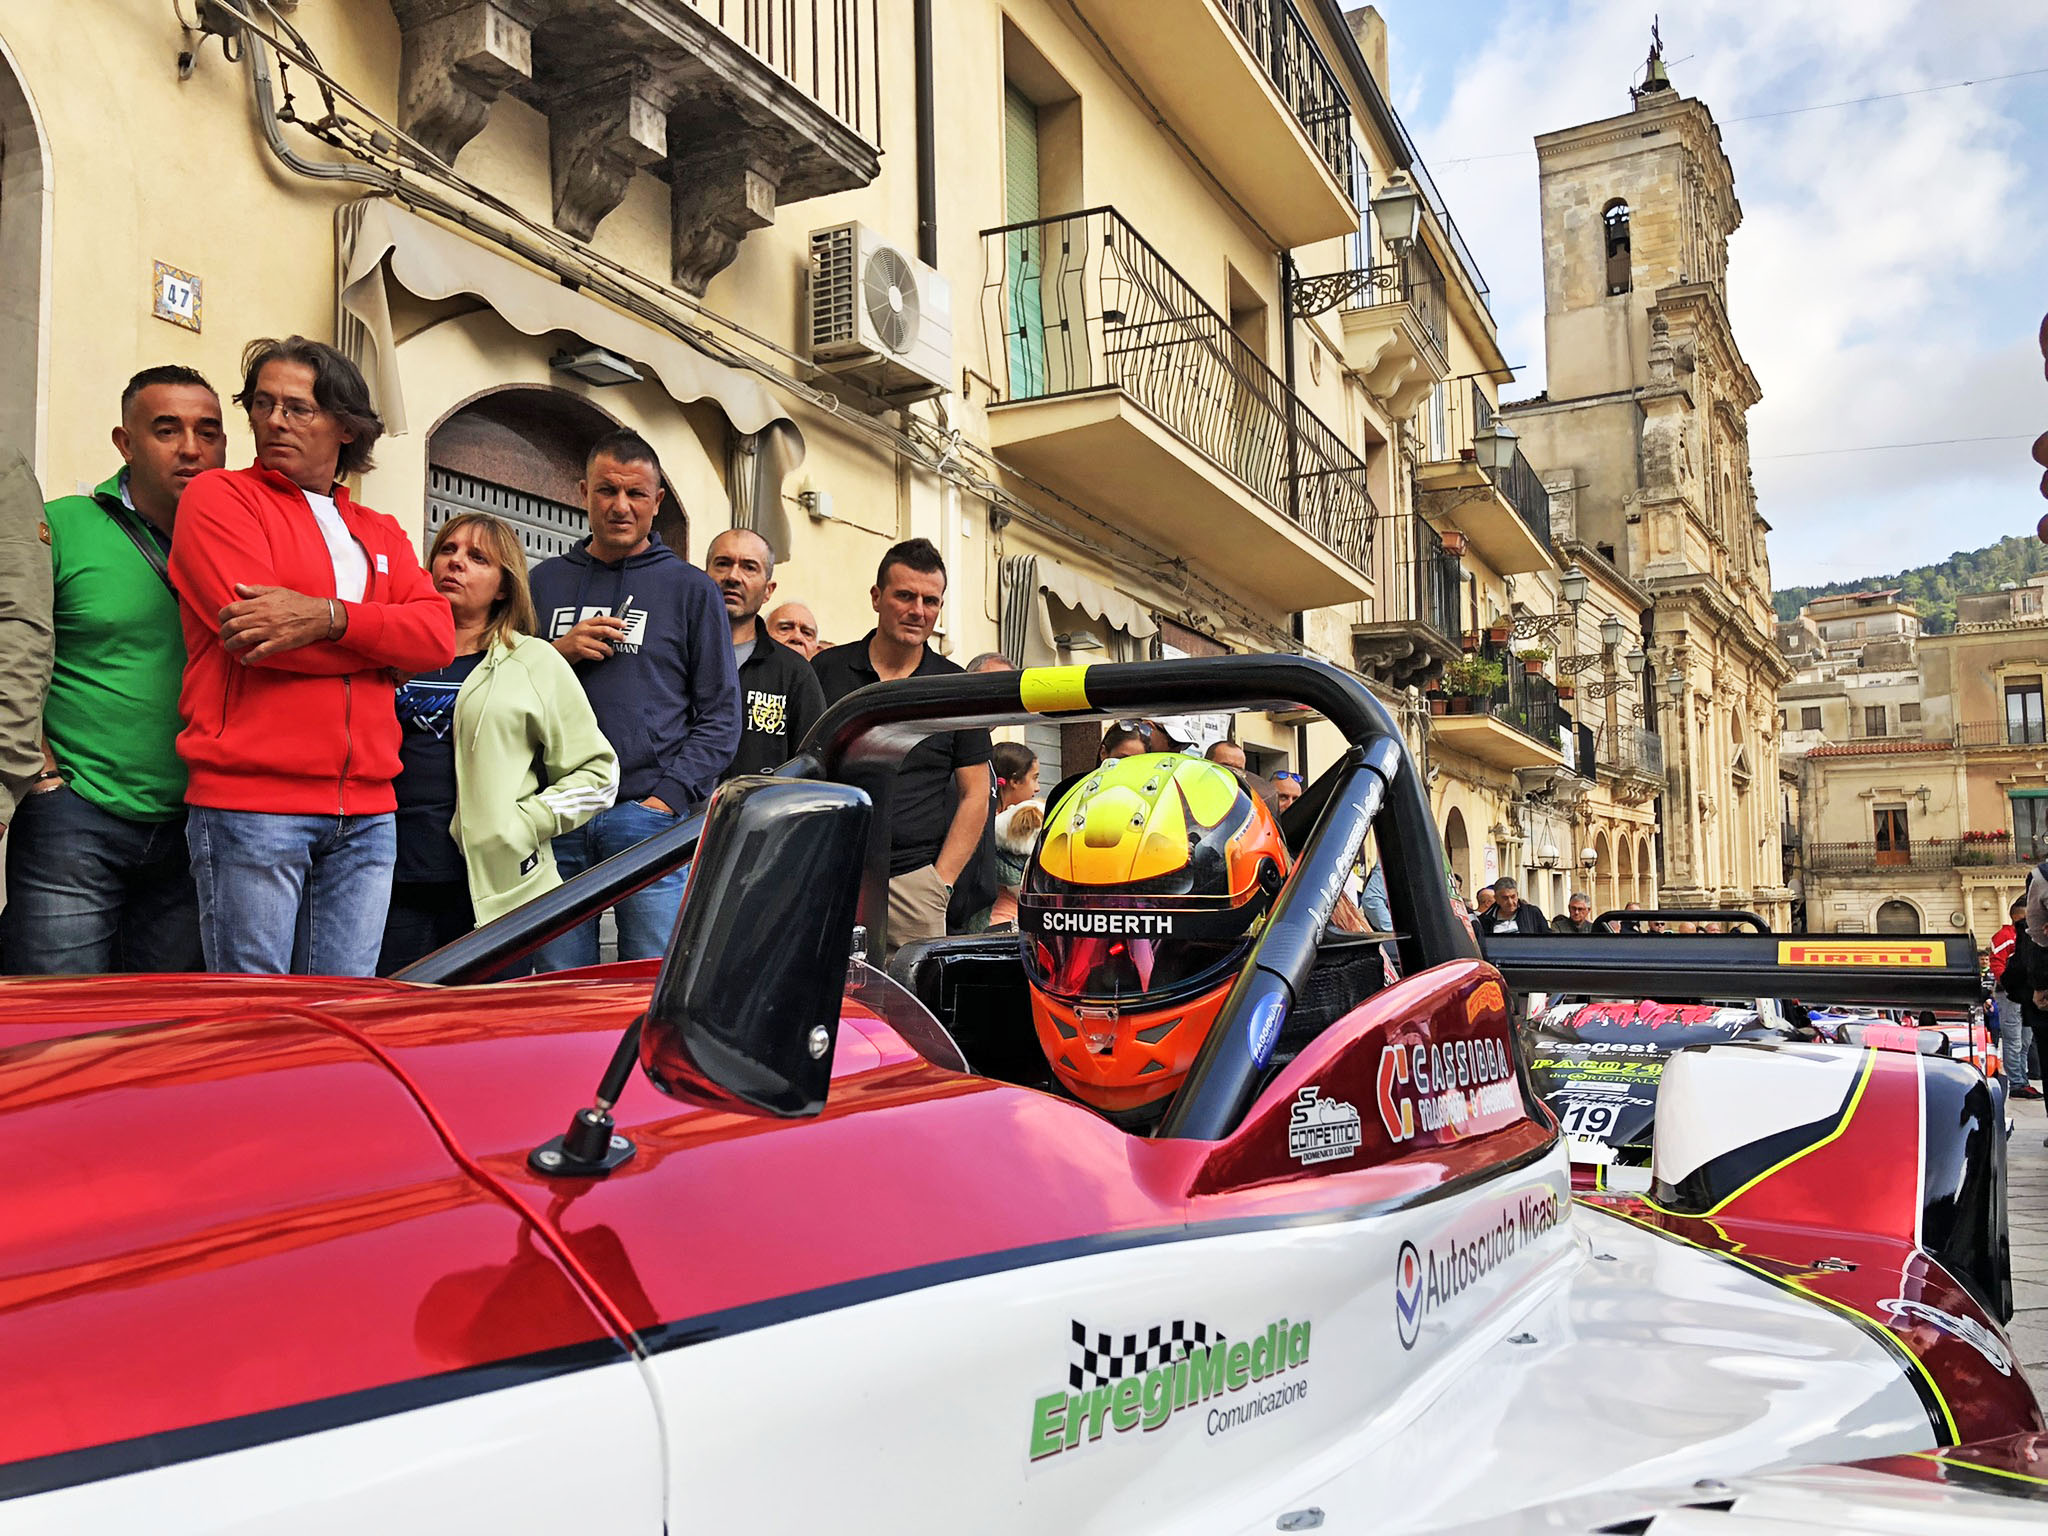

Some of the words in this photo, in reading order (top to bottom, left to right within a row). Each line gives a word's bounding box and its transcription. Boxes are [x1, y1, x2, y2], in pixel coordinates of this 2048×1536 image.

[168, 284, 190, 308] 47
[746, 714, 786, 736] 1982
[1042, 911, 1173, 934] SCHUBERTH
[1789, 946, 1932, 963] PIRELLI
[1534, 1041, 1659, 1053] Ecogest
[1569, 1106, 1612, 1133] 19
[1290, 1122, 1360, 1150] COMPETITION
[1426, 1208, 1515, 1315] Autoscuola
[1519, 1193, 1558, 1249] Nicaso
[1029, 1318, 1311, 1463] ErregiMedia
[1207, 1379, 1308, 1436] Comunicazione
